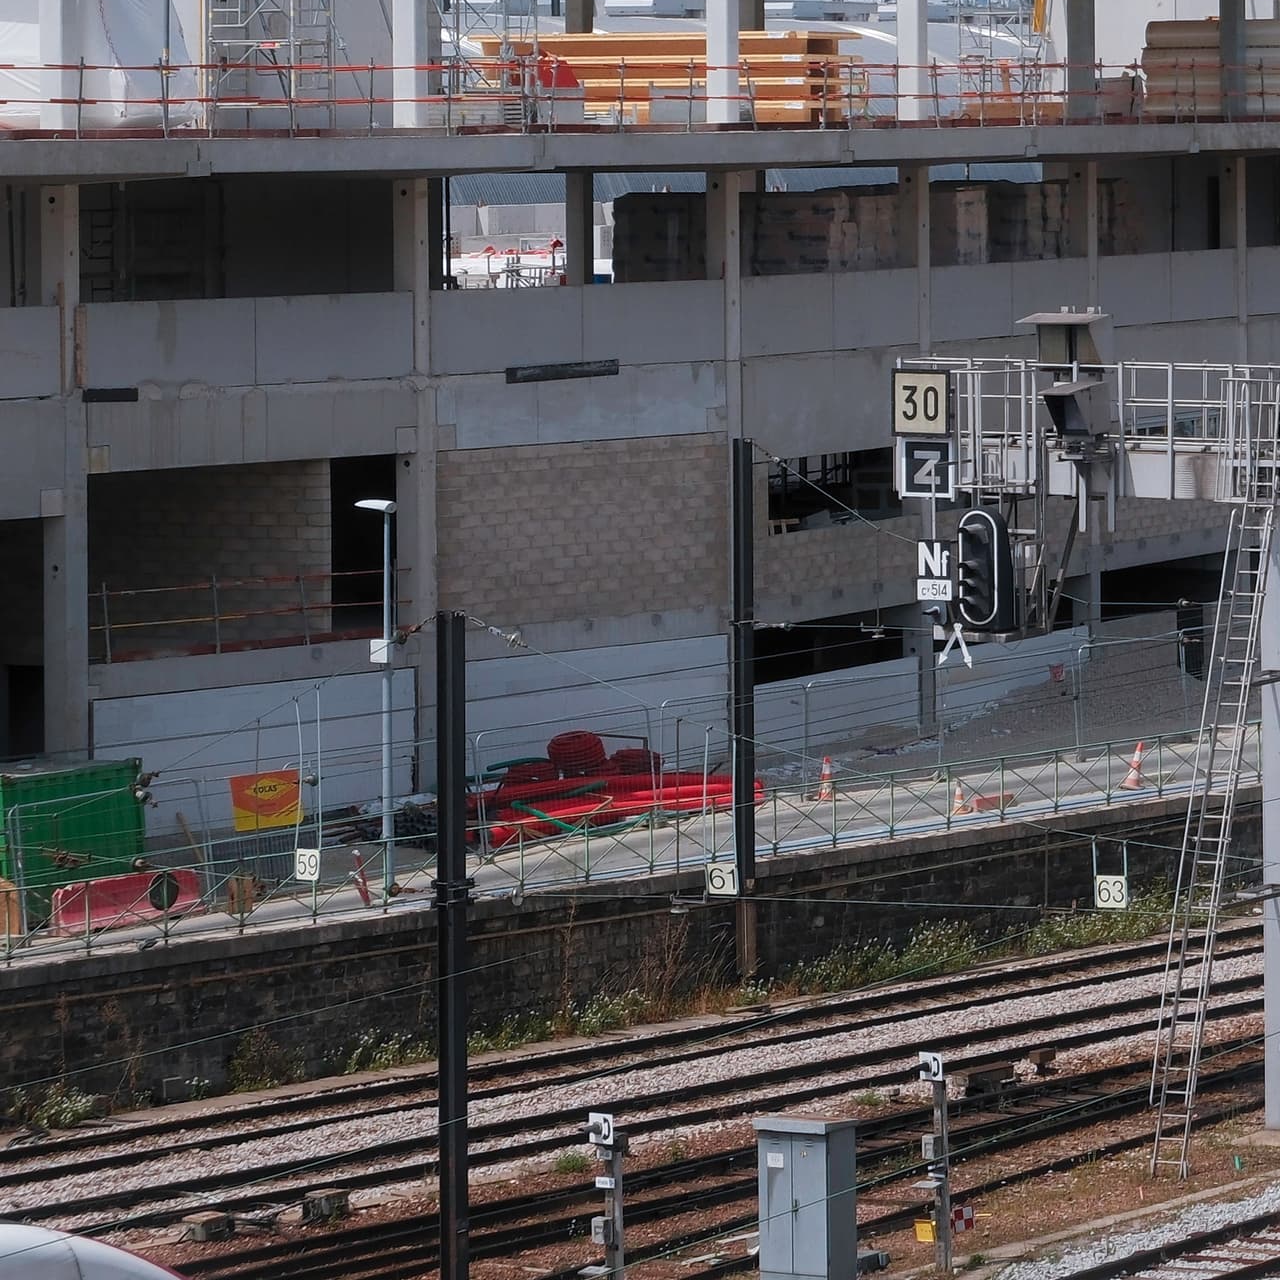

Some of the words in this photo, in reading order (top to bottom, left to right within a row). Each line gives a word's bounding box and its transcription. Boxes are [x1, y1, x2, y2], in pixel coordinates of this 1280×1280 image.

[902, 385, 938, 421] 30
[913, 450, 941, 485] Z
[918, 541, 950, 577] Nf
[253, 784, 278, 794] COLAS
[297, 854, 318, 876] 59
[709, 867, 736, 890] 61
[1098, 880, 1125, 903] 63
